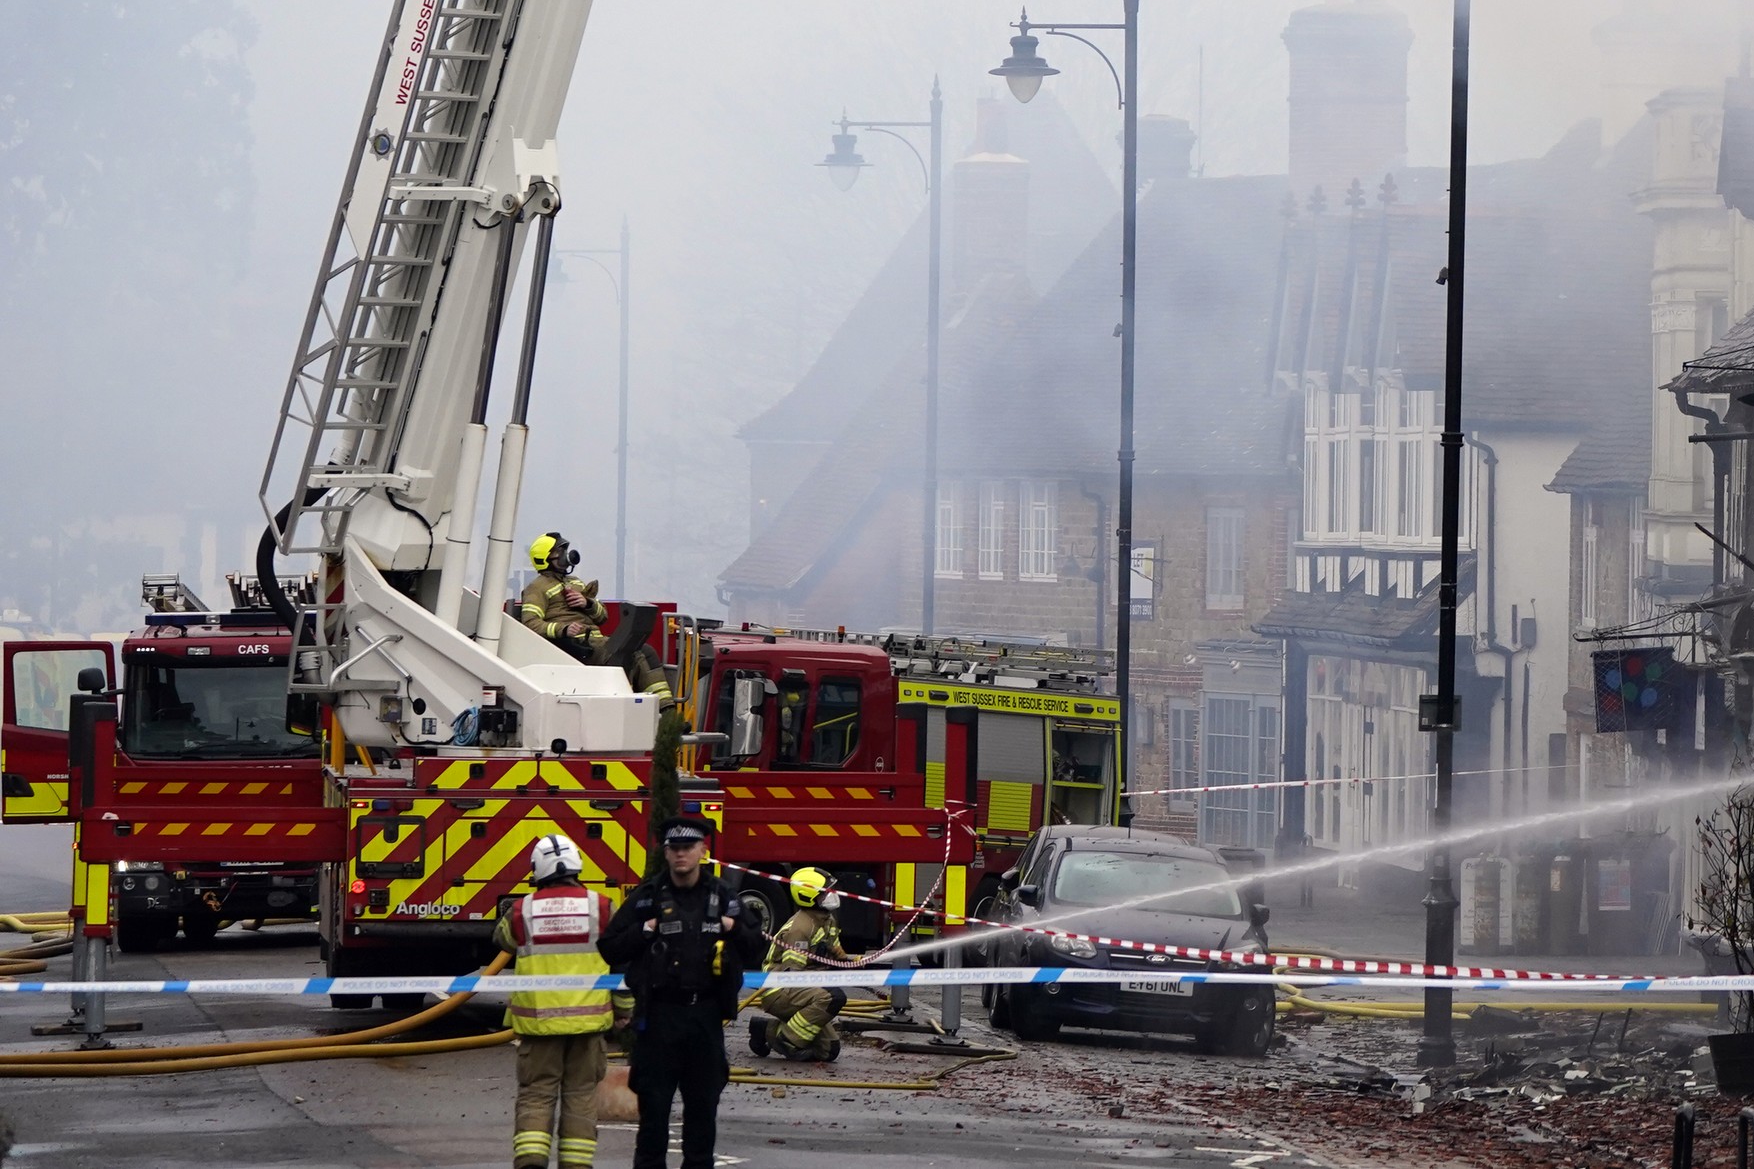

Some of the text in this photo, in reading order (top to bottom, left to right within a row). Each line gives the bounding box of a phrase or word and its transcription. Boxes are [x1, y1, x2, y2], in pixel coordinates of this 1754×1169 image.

[395, 57, 418, 106] WEST
[237, 644, 270, 655] CAFS
[952, 691, 1069, 713] WEST SUSSEX FIRE & RESCUE SERVICE
[396, 901, 460, 918] Angloco
